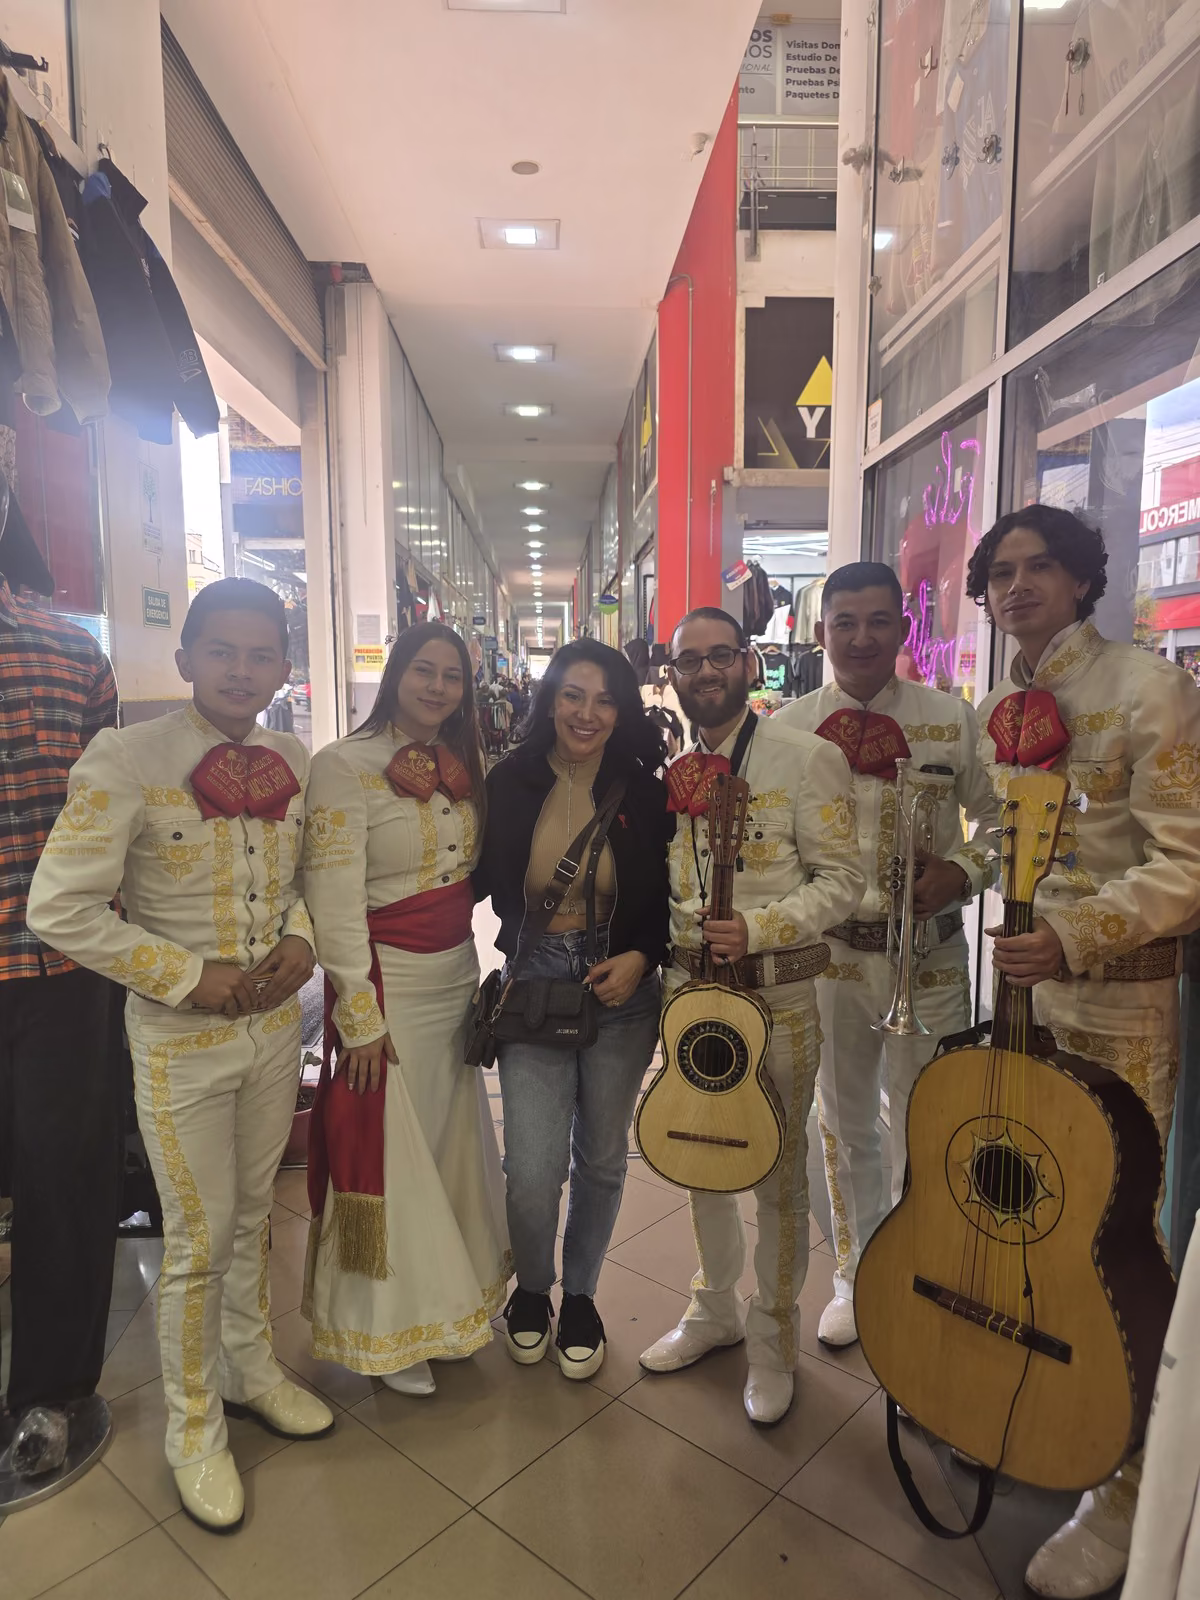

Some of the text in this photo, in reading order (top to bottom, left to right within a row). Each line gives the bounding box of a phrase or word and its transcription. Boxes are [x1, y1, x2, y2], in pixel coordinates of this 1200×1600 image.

[786, 41, 819, 49] Visitas
[786, 53, 838, 62] Estudio De
[785, 65, 826, 74] Pruebas
[785, 78, 825, 87] Pruebas
[785, 90, 830, 100] Paquetes
[243, 477, 304, 497] FASHIO
